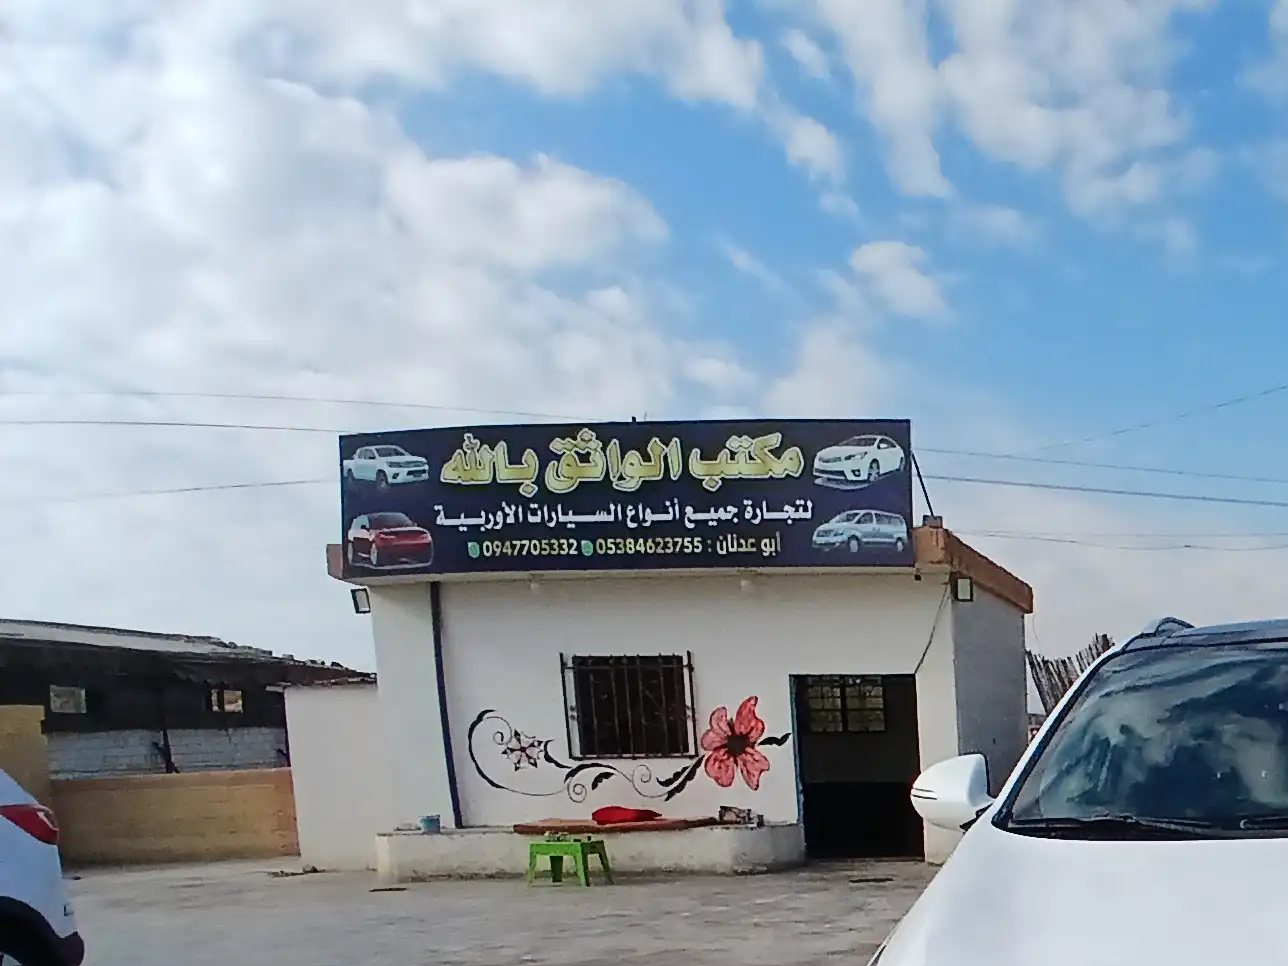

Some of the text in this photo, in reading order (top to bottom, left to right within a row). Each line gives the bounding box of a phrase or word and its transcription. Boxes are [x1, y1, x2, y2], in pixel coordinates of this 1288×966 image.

[440, 428, 804, 498] مكتب الواثق بالله
[527, 501, 622, 528] السيارات
[626, 497, 680, 529] أنواع
[684, 505, 738, 529] جميع
[743, 499, 812, 524] لتجارة
[482, 538, 578, 557] 0947705332
[595, 537, 703, 555] 05384623755
[716, 533, 757, 555] عدنان
